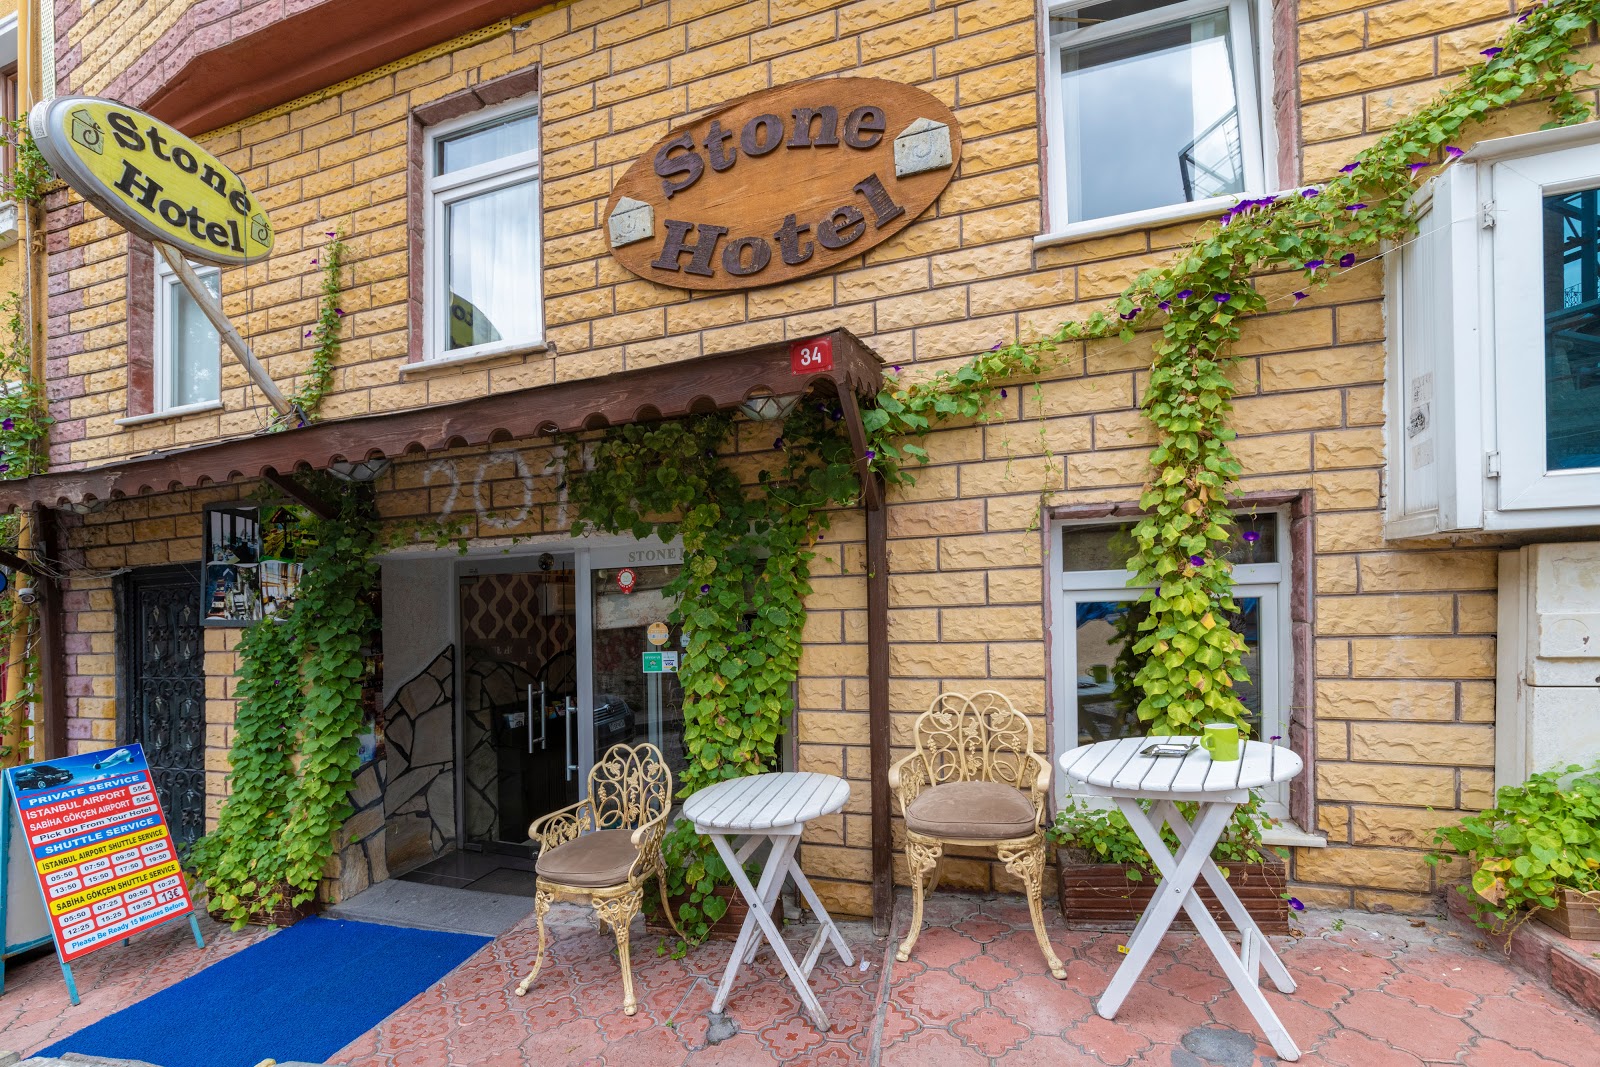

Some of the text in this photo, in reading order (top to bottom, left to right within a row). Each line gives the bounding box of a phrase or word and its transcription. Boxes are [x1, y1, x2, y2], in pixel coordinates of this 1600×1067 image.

[106, 111, 252, 217] Stone
[653, 104, 887, 200] Stone
[113, 159, 245, 254] Hotel
[651, 172, 905, 278] Hotel
[800, 346, 822, 367] 34
[628, 547, 677, 563] STONE
[26, 784, 148, 820] İSTANBUL AIRPORT 55€
[28, 774, 140, 806] PRIVATE SERVICE
[30, 795, 150, 832] SABİHA GÖKÇEN AIRPORT 55€
[40, 806, 152, 841] Pick Up From Your Hotel
[42, 828, 163, 871] İSTANBUL AIRPORT SHUTTLE SERVICE
[44, 818, 155, 854] SHUTTLE SERVICE
[50, 842, 164, 882] 05:50 07:50 09:50 10:50
[55, 882, 77, 894] 13:50
[88, 872, 109, 883] 15:50
[56, 864, 176, 911] SABİHA GÖKÇEN SHUTTLE SERVICE
[64, 878, 176, 923] 05:50 07:25 09:50 10:25
[68, 923, 90, 936] 12:25
[101, 912, 122, 923] 15:25
[161, 888, 180, 902] 13€
[72, 900, 185, 949] Please Be Ready 15 Minutes Before
